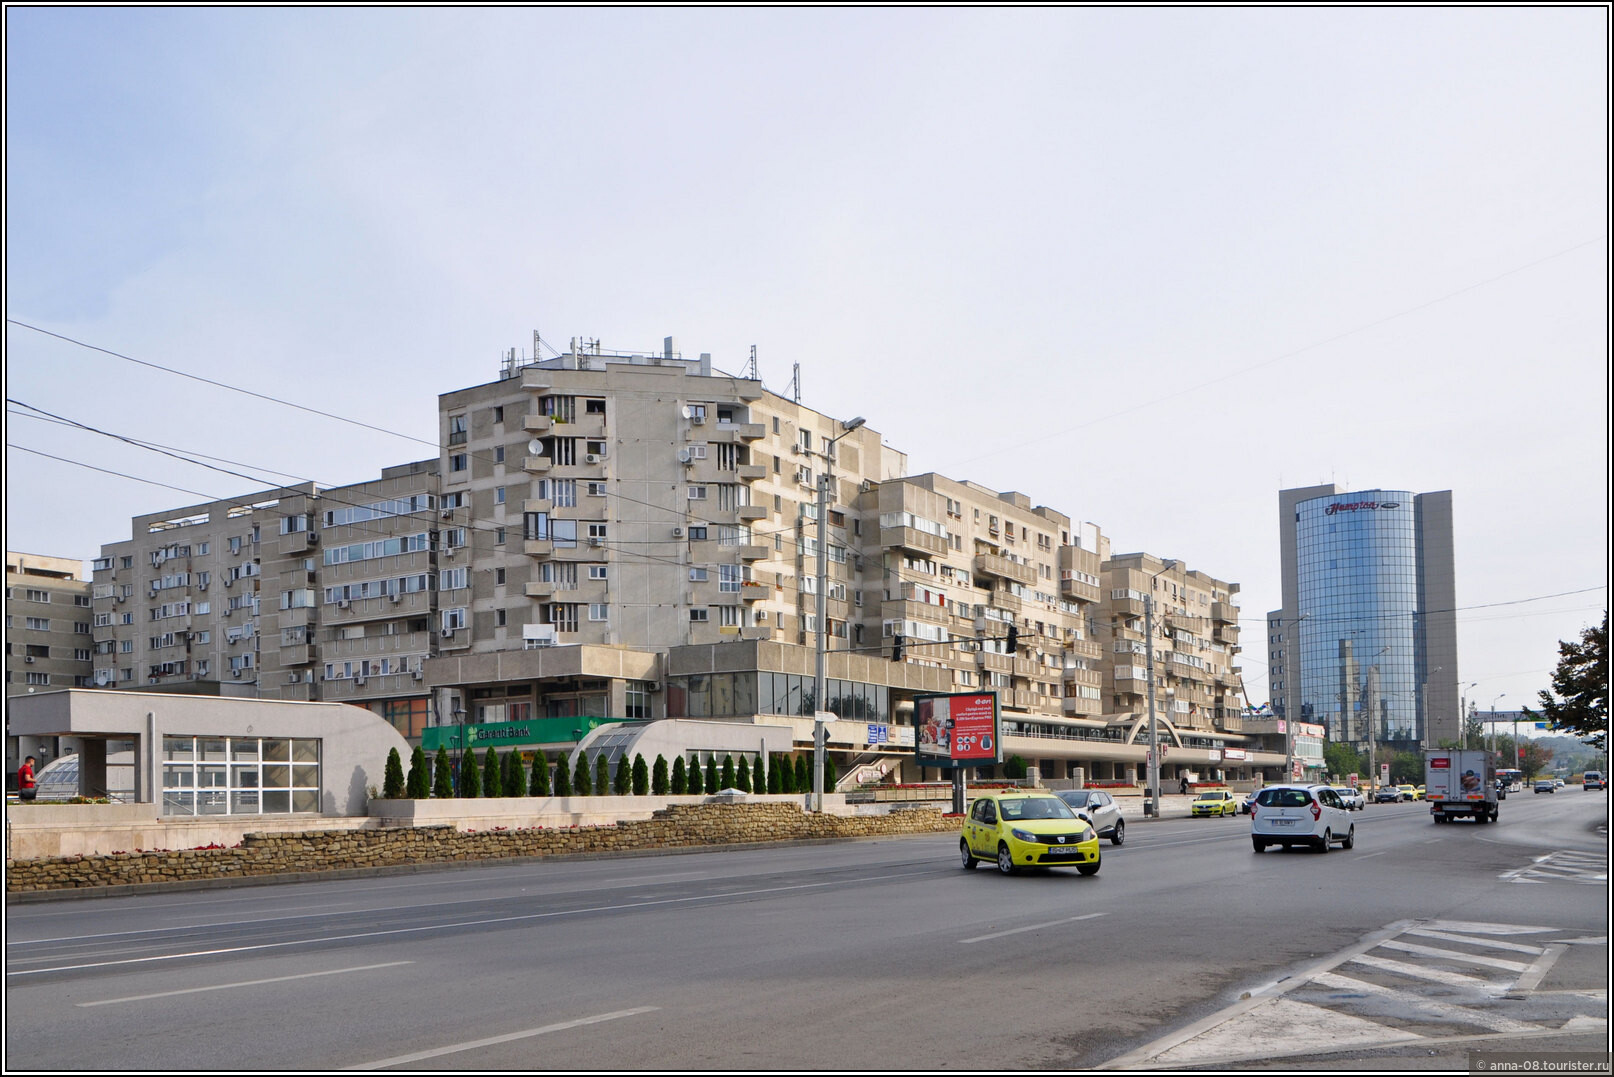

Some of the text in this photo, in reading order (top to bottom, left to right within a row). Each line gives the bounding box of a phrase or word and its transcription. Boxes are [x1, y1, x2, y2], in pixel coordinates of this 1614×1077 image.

[1325, 501, 1379, 515] Hampton
[478, 725, 530, 739] Garanti Bank
